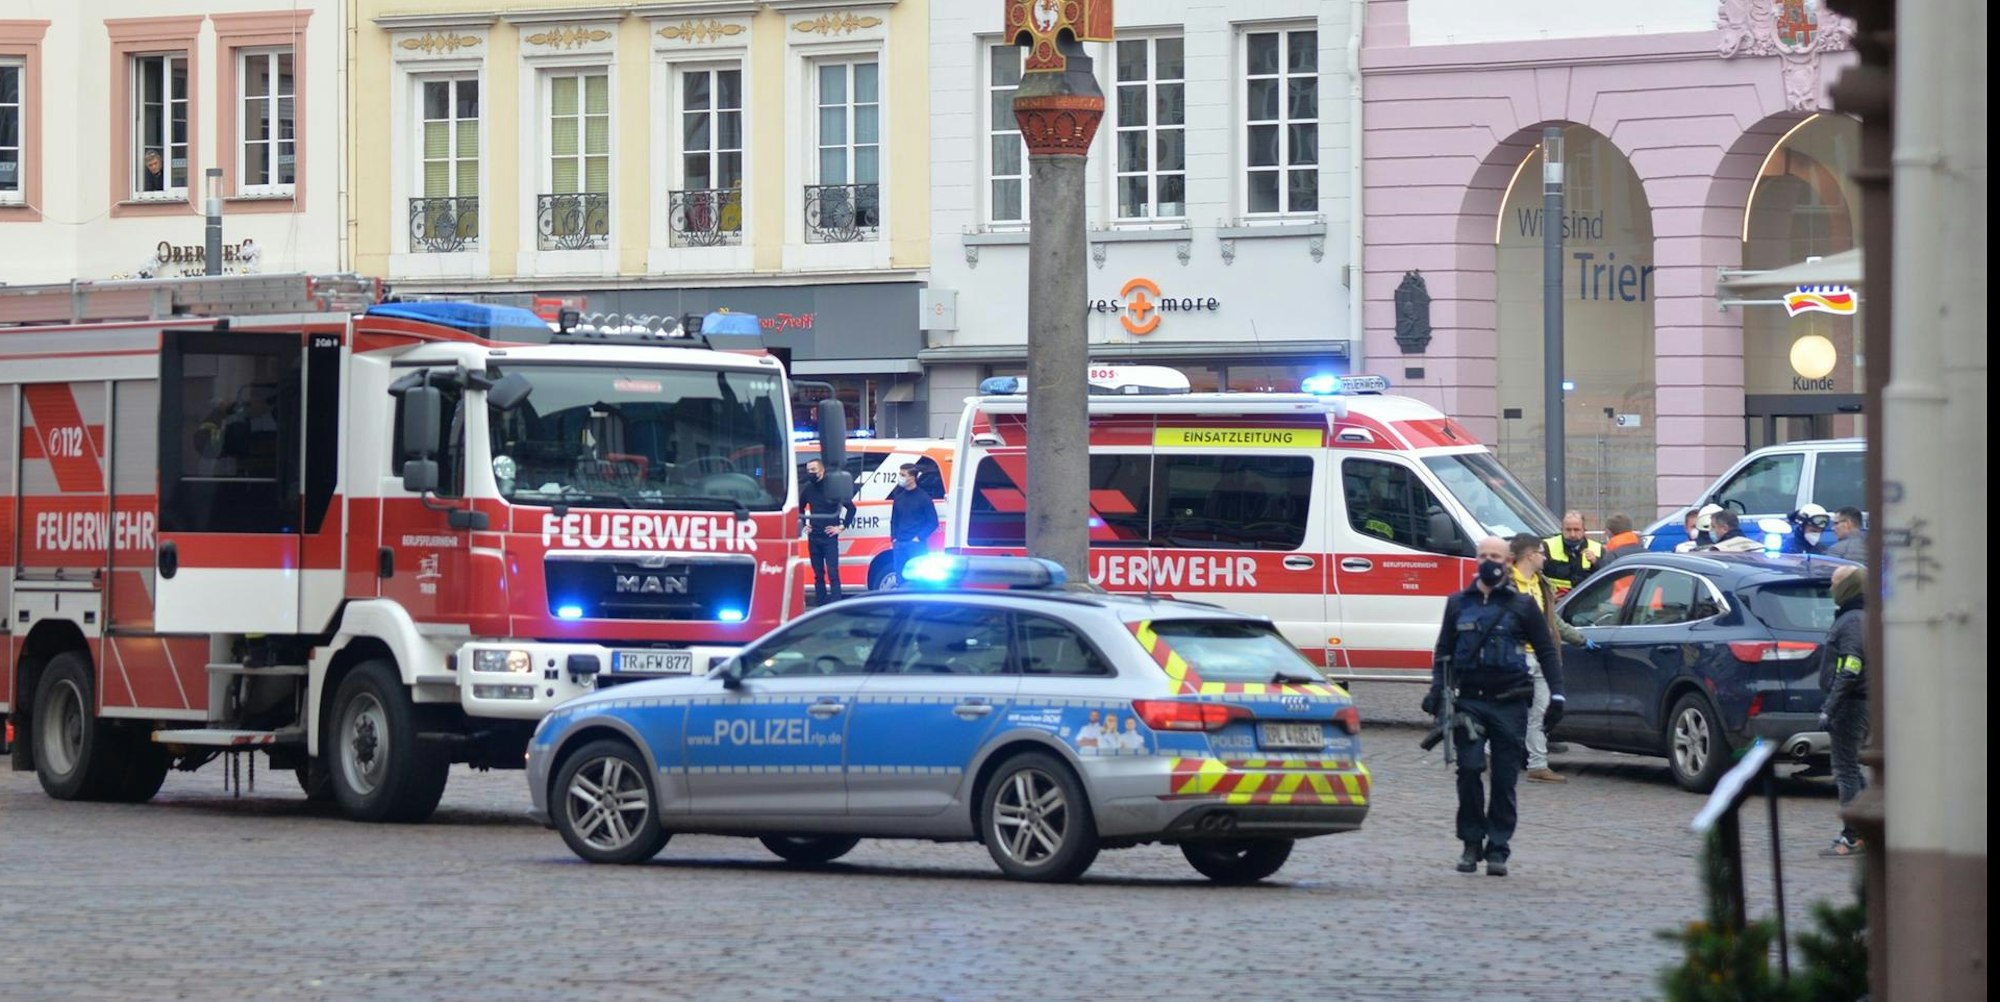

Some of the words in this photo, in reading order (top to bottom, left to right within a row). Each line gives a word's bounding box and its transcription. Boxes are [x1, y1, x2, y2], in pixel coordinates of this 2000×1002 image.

[1517, 207, 1543, 237] Wi
[1561, 210, 1604, 240] sind
[1573, 252, 1656, 302] Trier
[1161, 297, 1217, 311] more
[1091, 370, 1115, 379] BOS
[1793, 376, 1834, 391] Kunde
[61, 426, 83, 457] 112
[1183, 431, 1293, 443] EINSATZLEITUNG
[882, 472, 897, 484] 112
[36, 511, 156, 550] FEUERWEHR
[542, 513, 758, 551] FEUERWEHR
[616, 575, 688, 594] MAN
[622, 654, 638, 669] TR
[646, 655, 663, 670] FW
[665, 655, 690, 670] 877
[687, 719, 842, 746] www.POLIZEI.rlp.de
[1211, 736, 1253, 748] POLIZEI
